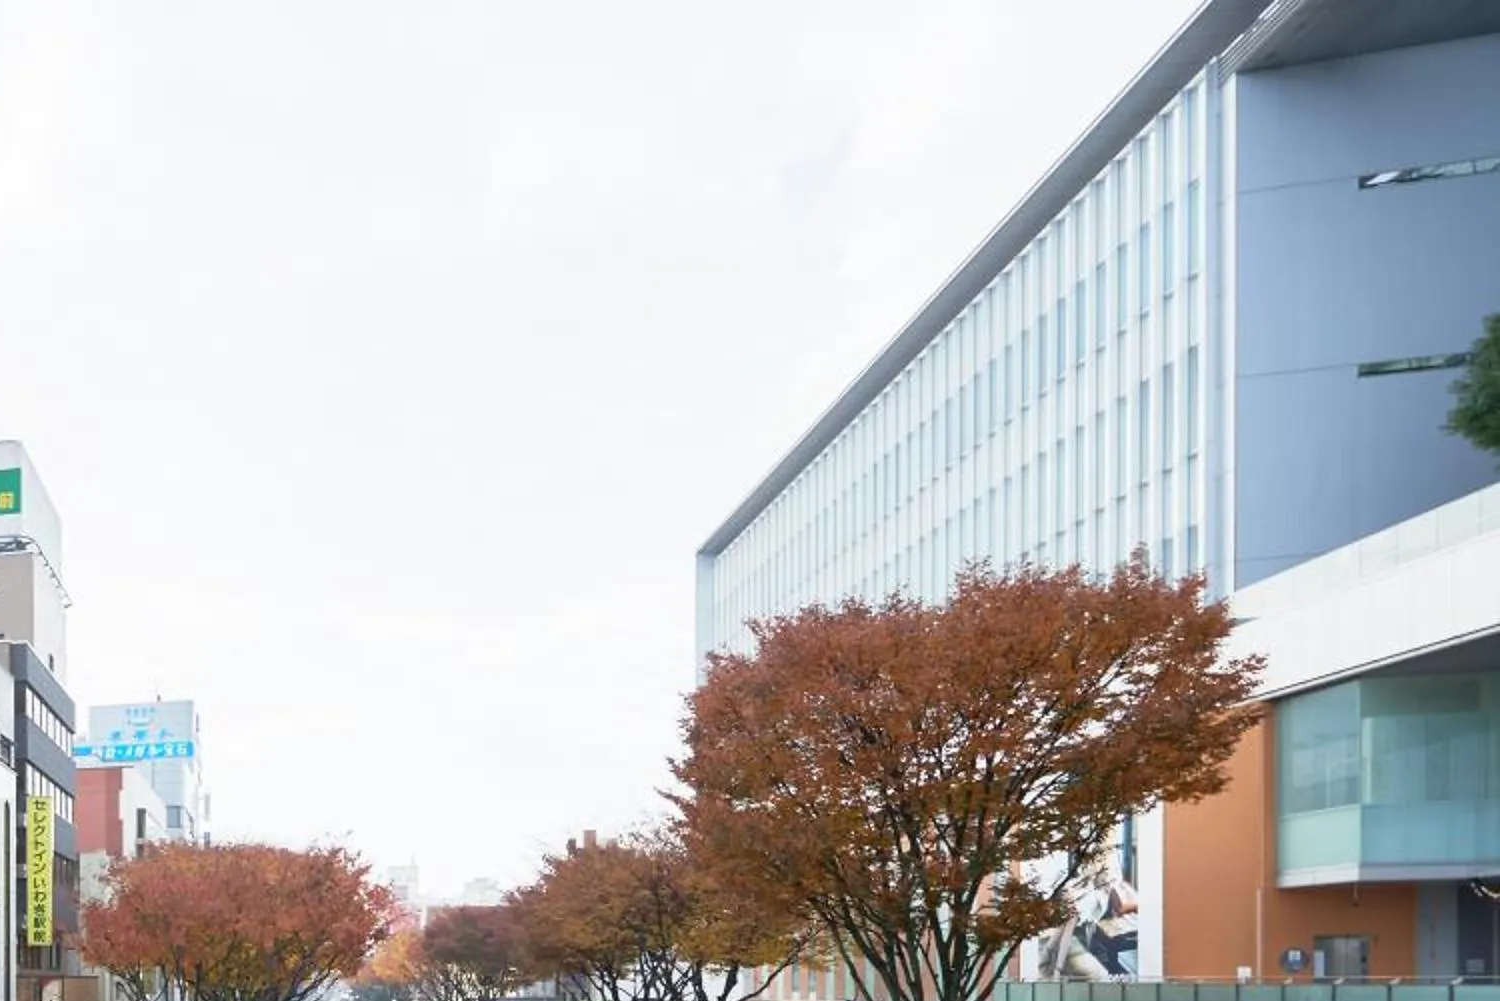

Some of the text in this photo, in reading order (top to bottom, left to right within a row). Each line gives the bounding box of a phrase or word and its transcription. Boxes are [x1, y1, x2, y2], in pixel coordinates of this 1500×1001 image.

[32, 799, 47, 943] セレクトインいわき駅前
